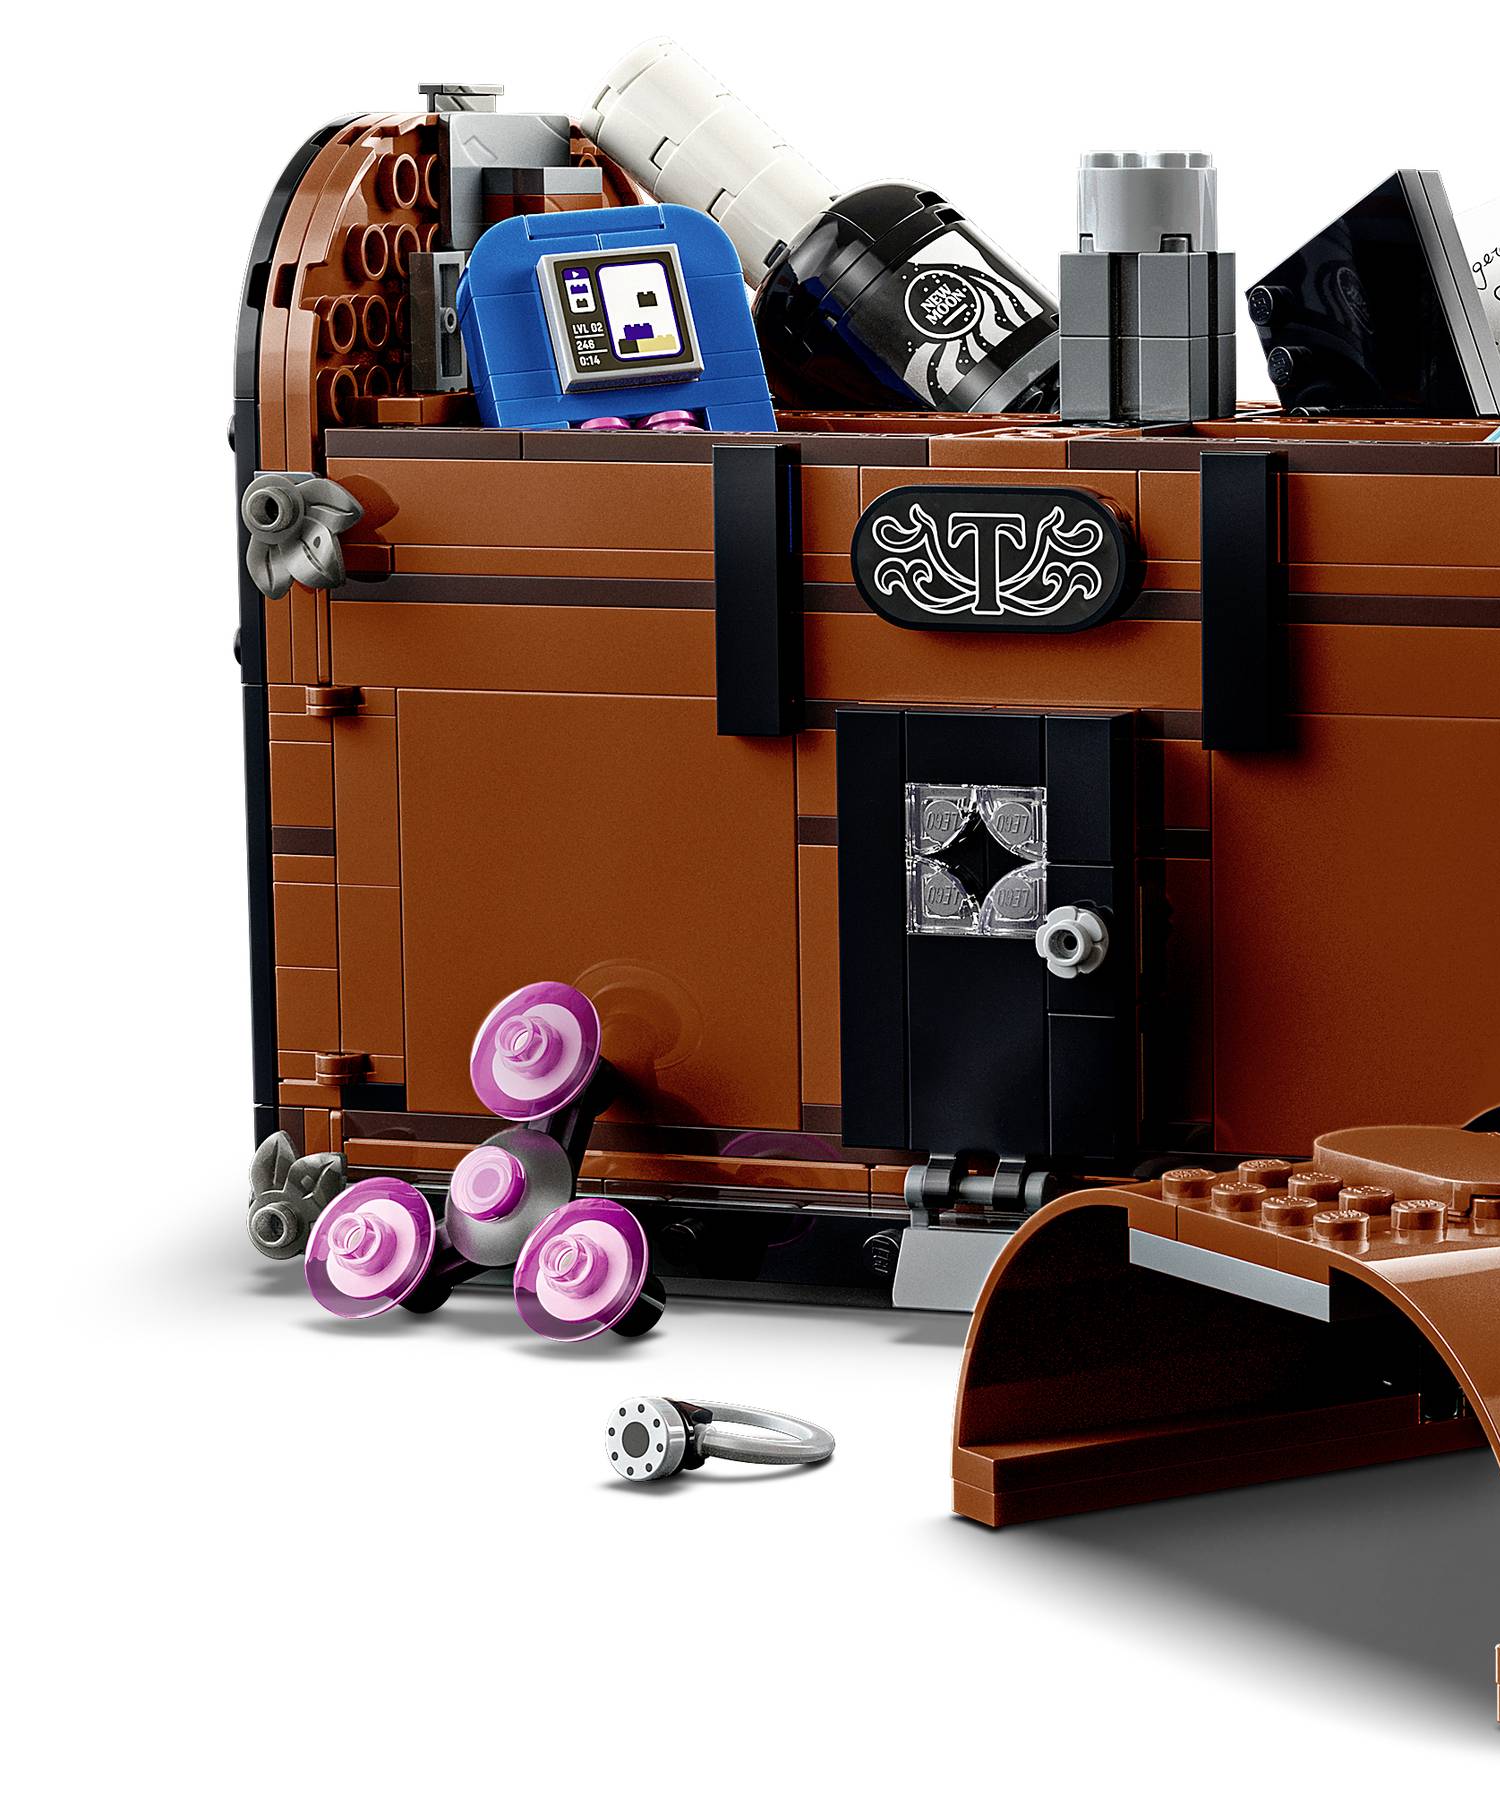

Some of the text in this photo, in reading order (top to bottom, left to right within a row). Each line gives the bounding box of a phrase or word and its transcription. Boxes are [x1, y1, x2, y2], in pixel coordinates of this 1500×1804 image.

[920, 283, 951, 313] NEW
[925, 288, 967, 325] MOON
[572, 321, 604, 334] LVL 02
[579, 355, 601, 366] 0:14
[948, 512, 1026, 616] T
[926, 811, 959, 831] LEGO
[996, 813, 1029, 834] LEGO
[927, 885, 959, 905] LEGO
[997, 887, 1030, 908] LEGO
